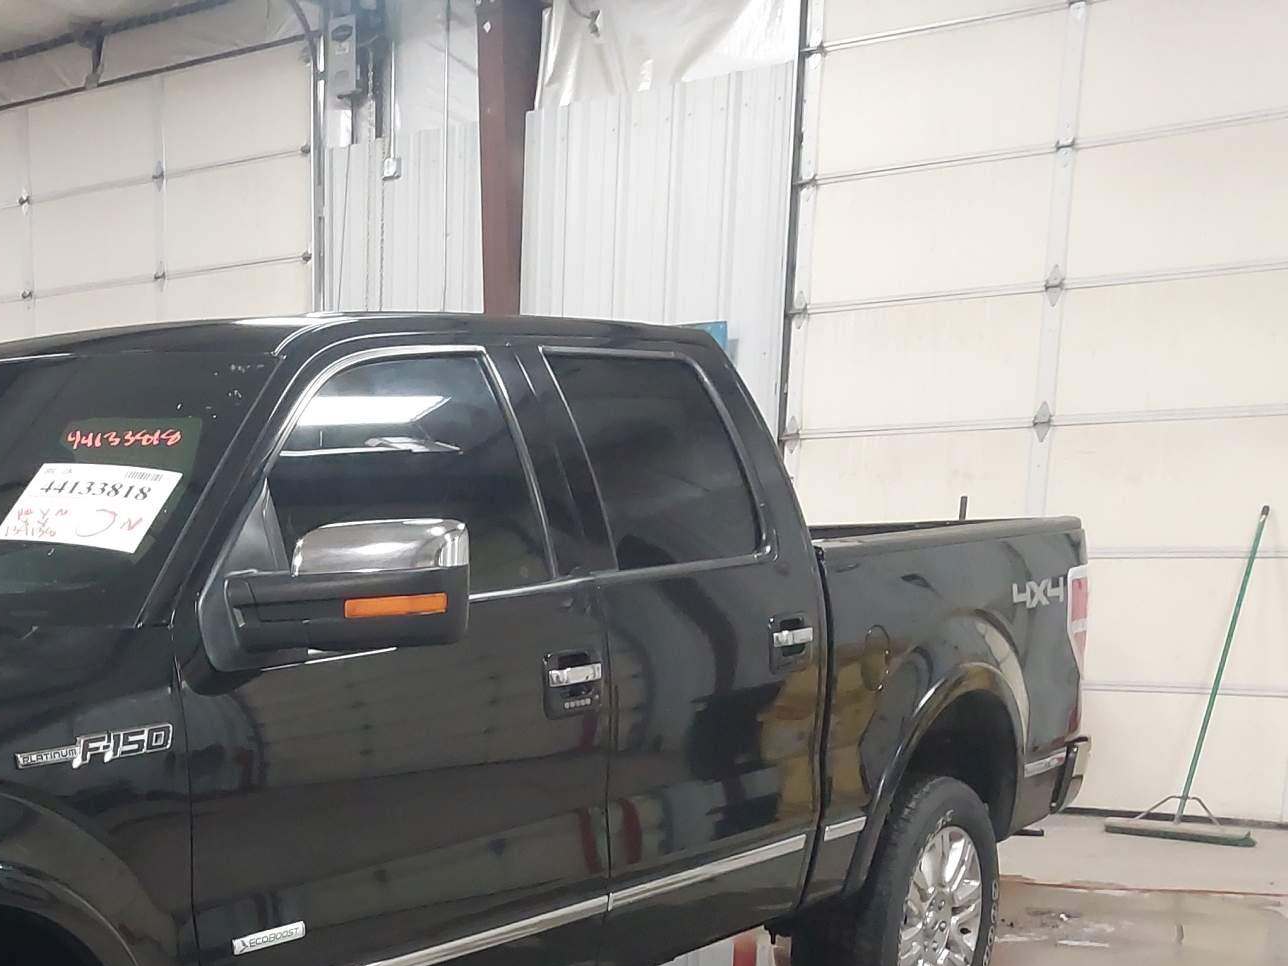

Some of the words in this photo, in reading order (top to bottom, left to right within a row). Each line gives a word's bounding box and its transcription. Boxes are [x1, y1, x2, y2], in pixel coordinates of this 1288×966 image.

[67, 429, 181, 449] 44133818
[40, 480, 152, 500] 44133818
[22, 748, 77, 765] PLATINUM
